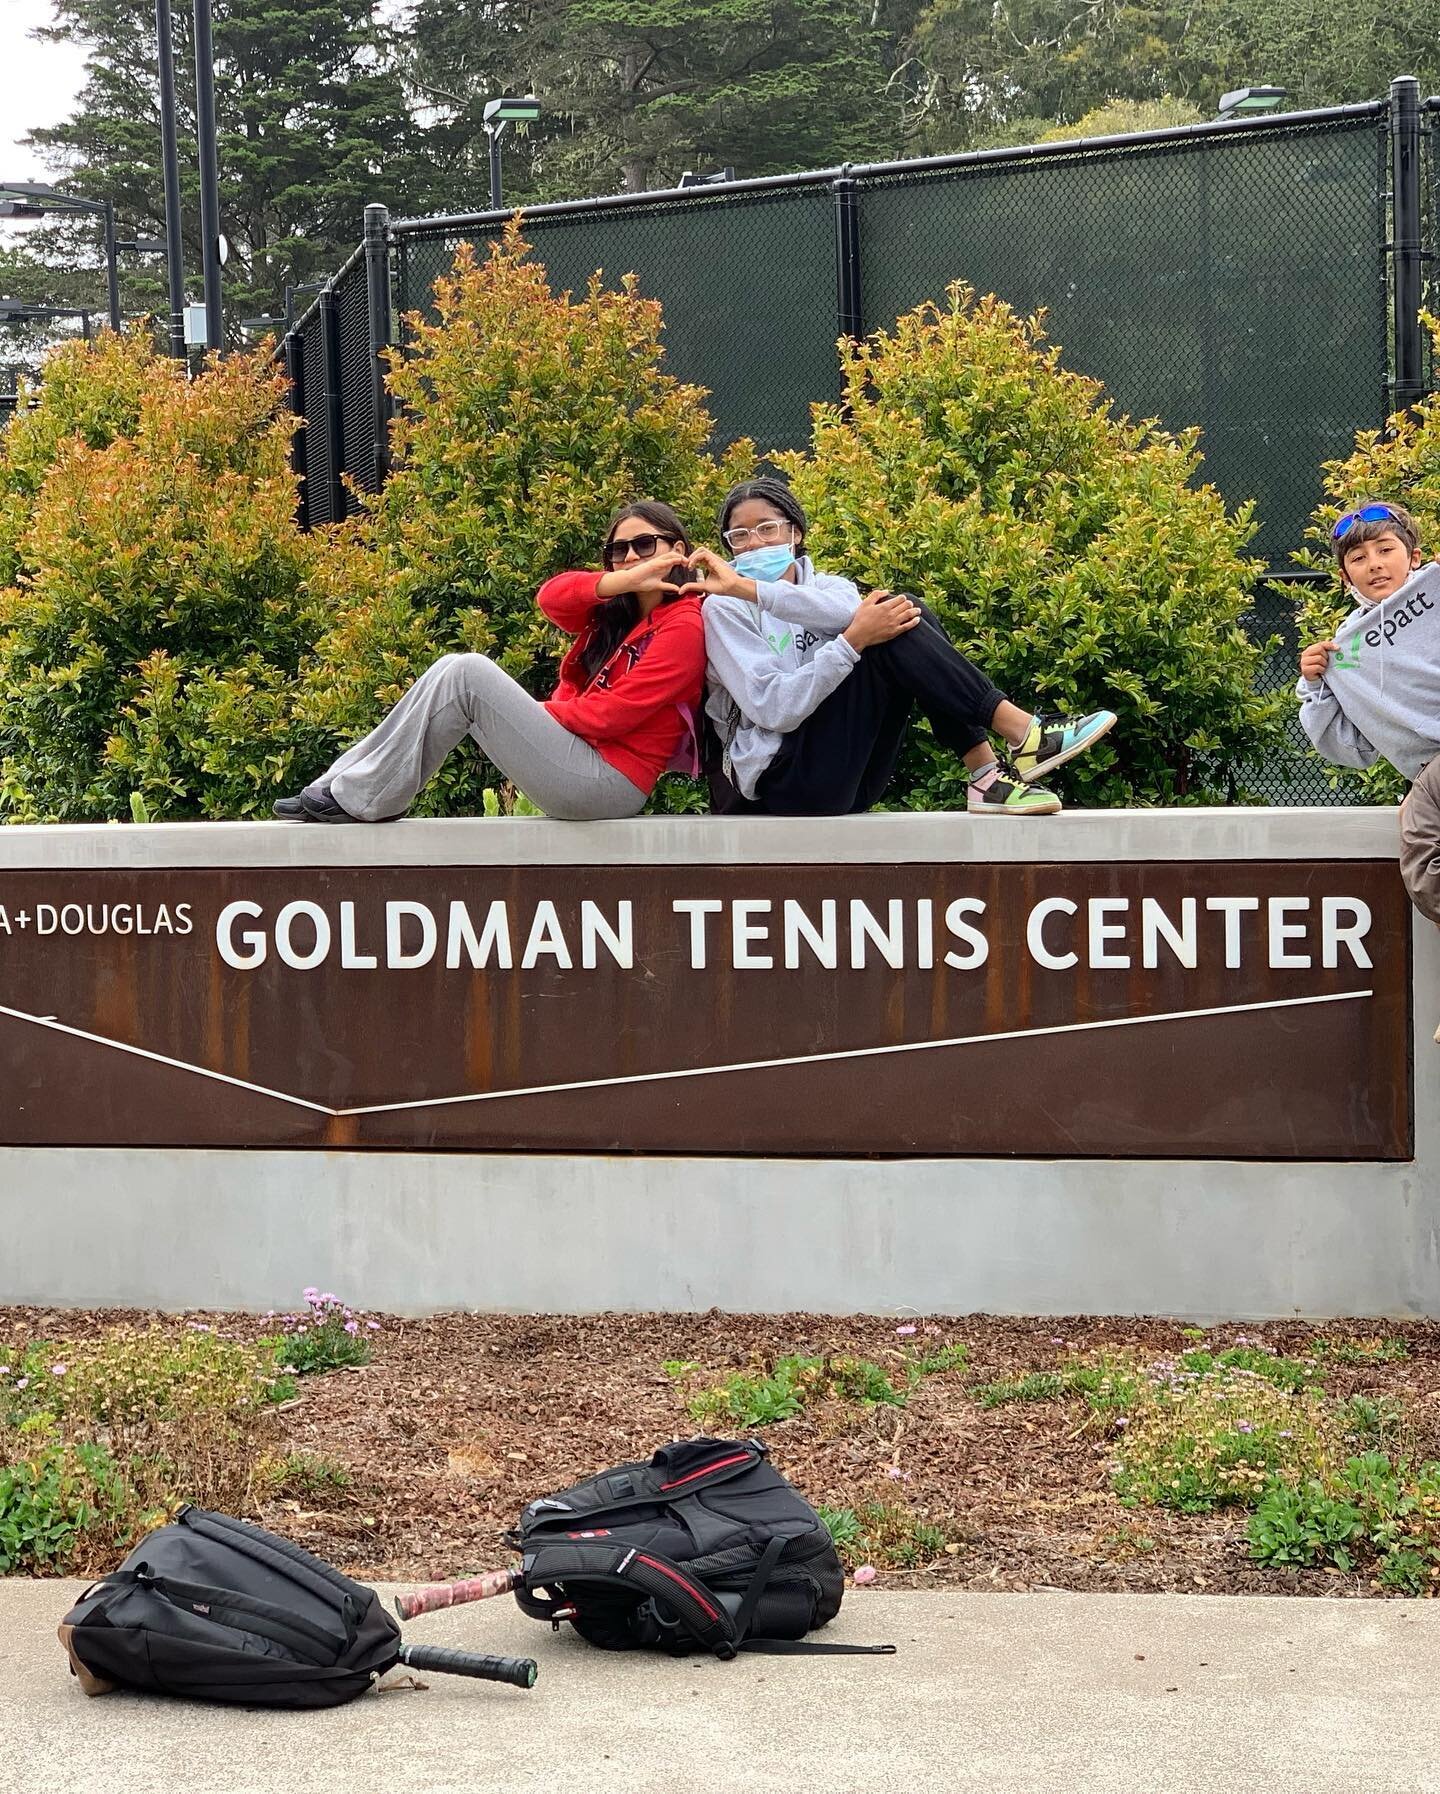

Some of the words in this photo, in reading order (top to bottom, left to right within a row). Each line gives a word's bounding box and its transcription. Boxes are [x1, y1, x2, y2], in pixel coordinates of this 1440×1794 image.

[1365, 592, 1434, 647] epatt
[216, 900, 635, 970] GOLDMAN
[672, 897, 989, 970] TENNIS
[1026, 896, 1373, 970] CENTER
